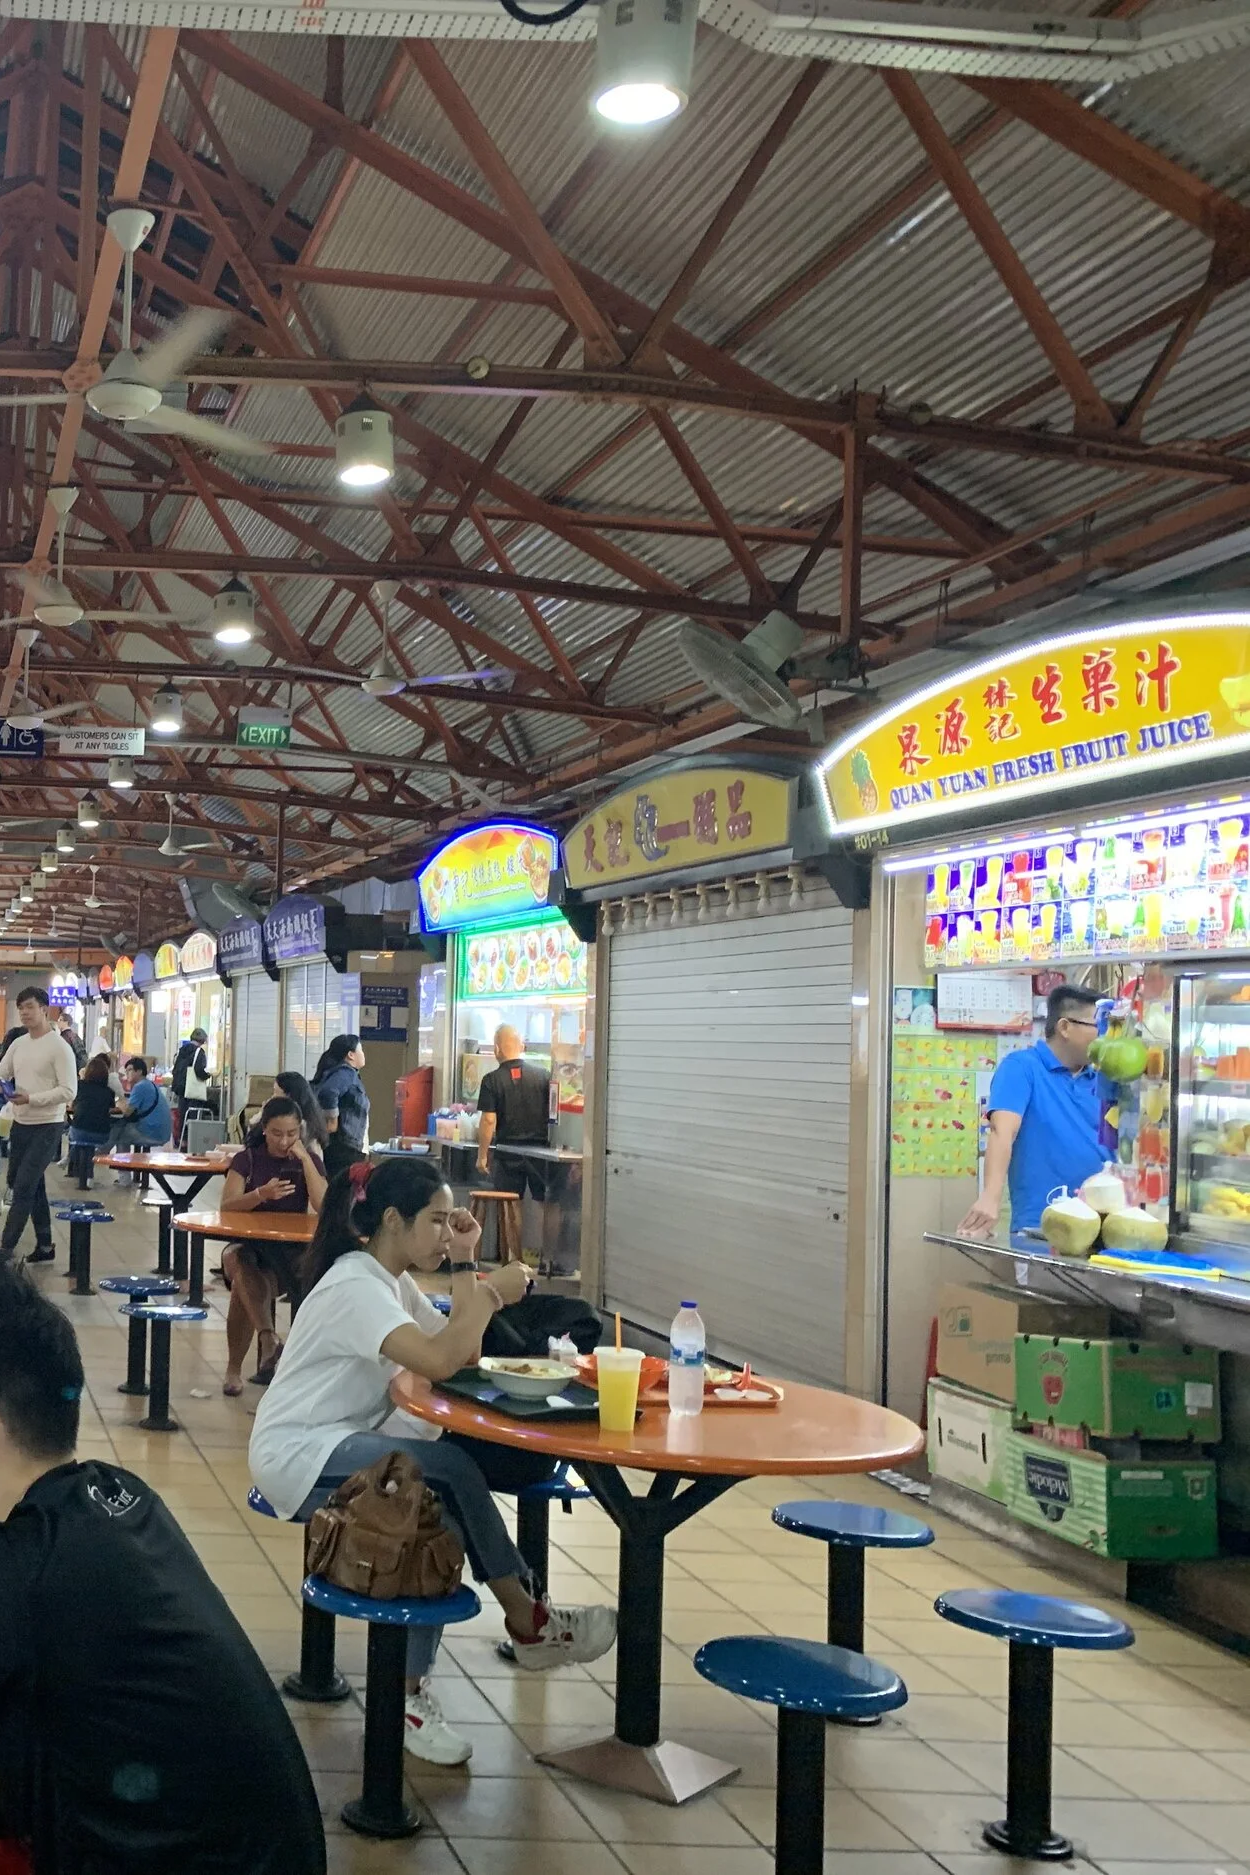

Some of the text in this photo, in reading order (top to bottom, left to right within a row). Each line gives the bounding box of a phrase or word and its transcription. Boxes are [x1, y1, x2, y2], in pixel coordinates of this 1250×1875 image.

[65, 731, 139, 741] CUSTOMERS CAN SIT
[249, 727, 280, 744] EXIT
[74, 742, 129, 751] AT ANY TABLES
[890, 713, 1211, 811] QUAN YUAN FRESH FRUIT JUICE
[855, 830, 889, 850] #01-14
